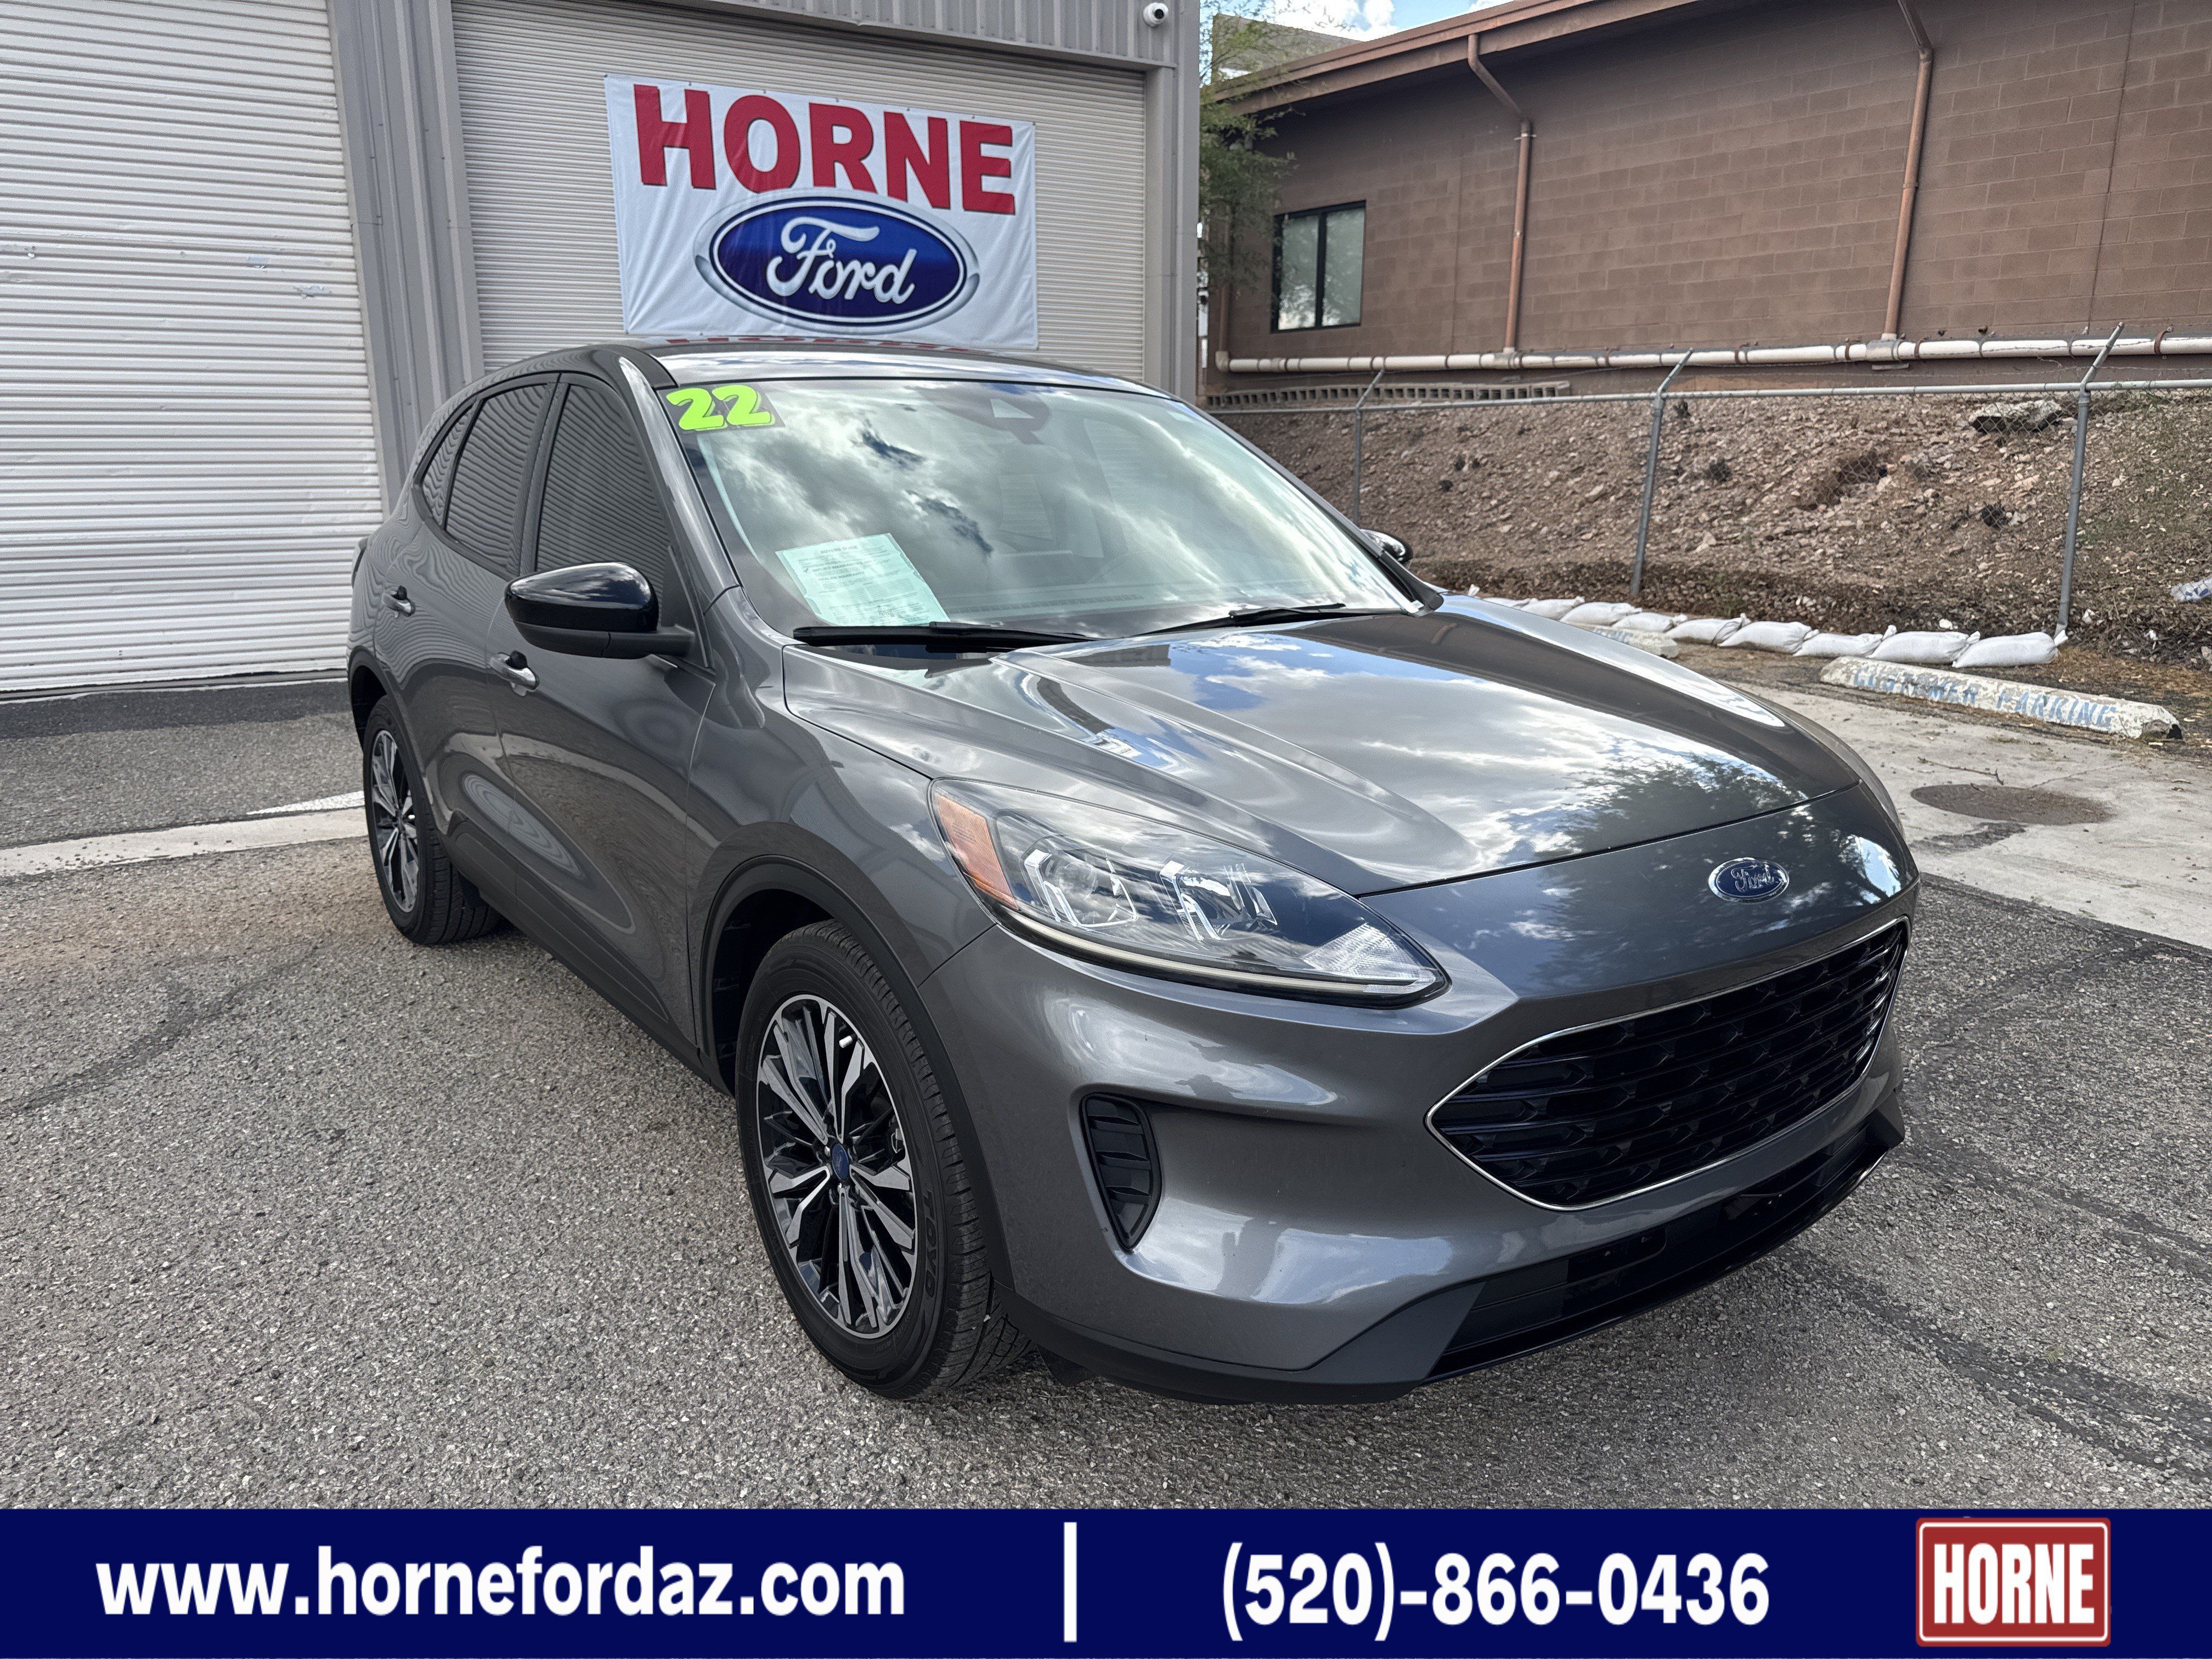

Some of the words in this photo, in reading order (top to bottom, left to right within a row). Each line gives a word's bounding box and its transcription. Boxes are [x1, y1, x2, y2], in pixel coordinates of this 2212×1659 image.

[633, 84, 1016, 215] HORNE
[766, 216, 918, 304] Ford
[665, 385, 775, 432] 22
[1996, 690, 2117, 729] PARKING
[1730, 863, 1775, 893] Ford
[921, 1189, 936, 1298] TOYO
